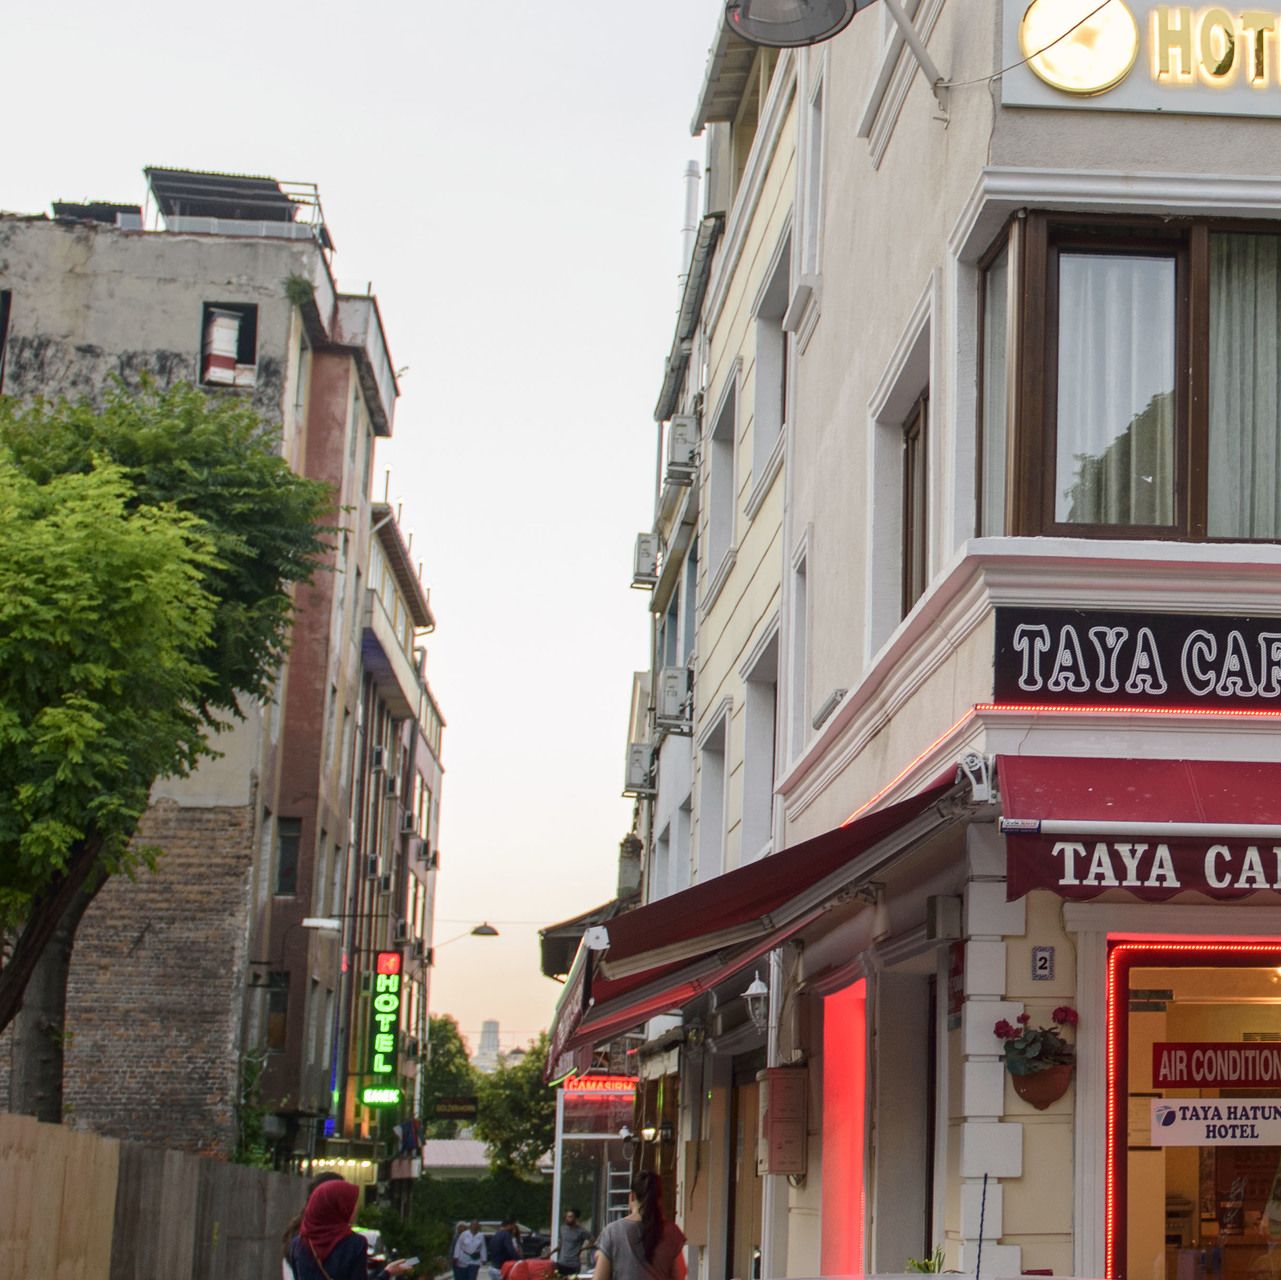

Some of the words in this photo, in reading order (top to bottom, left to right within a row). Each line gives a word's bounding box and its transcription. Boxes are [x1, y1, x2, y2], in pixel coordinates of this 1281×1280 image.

[1014, 624, 1168, 694] TAYA
[1051, 842, 1181, 888] TAYA
[1038, 956, 1048, 970] 2
[373, 974, 400, 1073] HOTEL
[1159, 1049, 1189, 1082] AIR
[1179, 1106, 1223, 1121] TAYA
[1205, 1124, 1259, 1139] HOTEL
